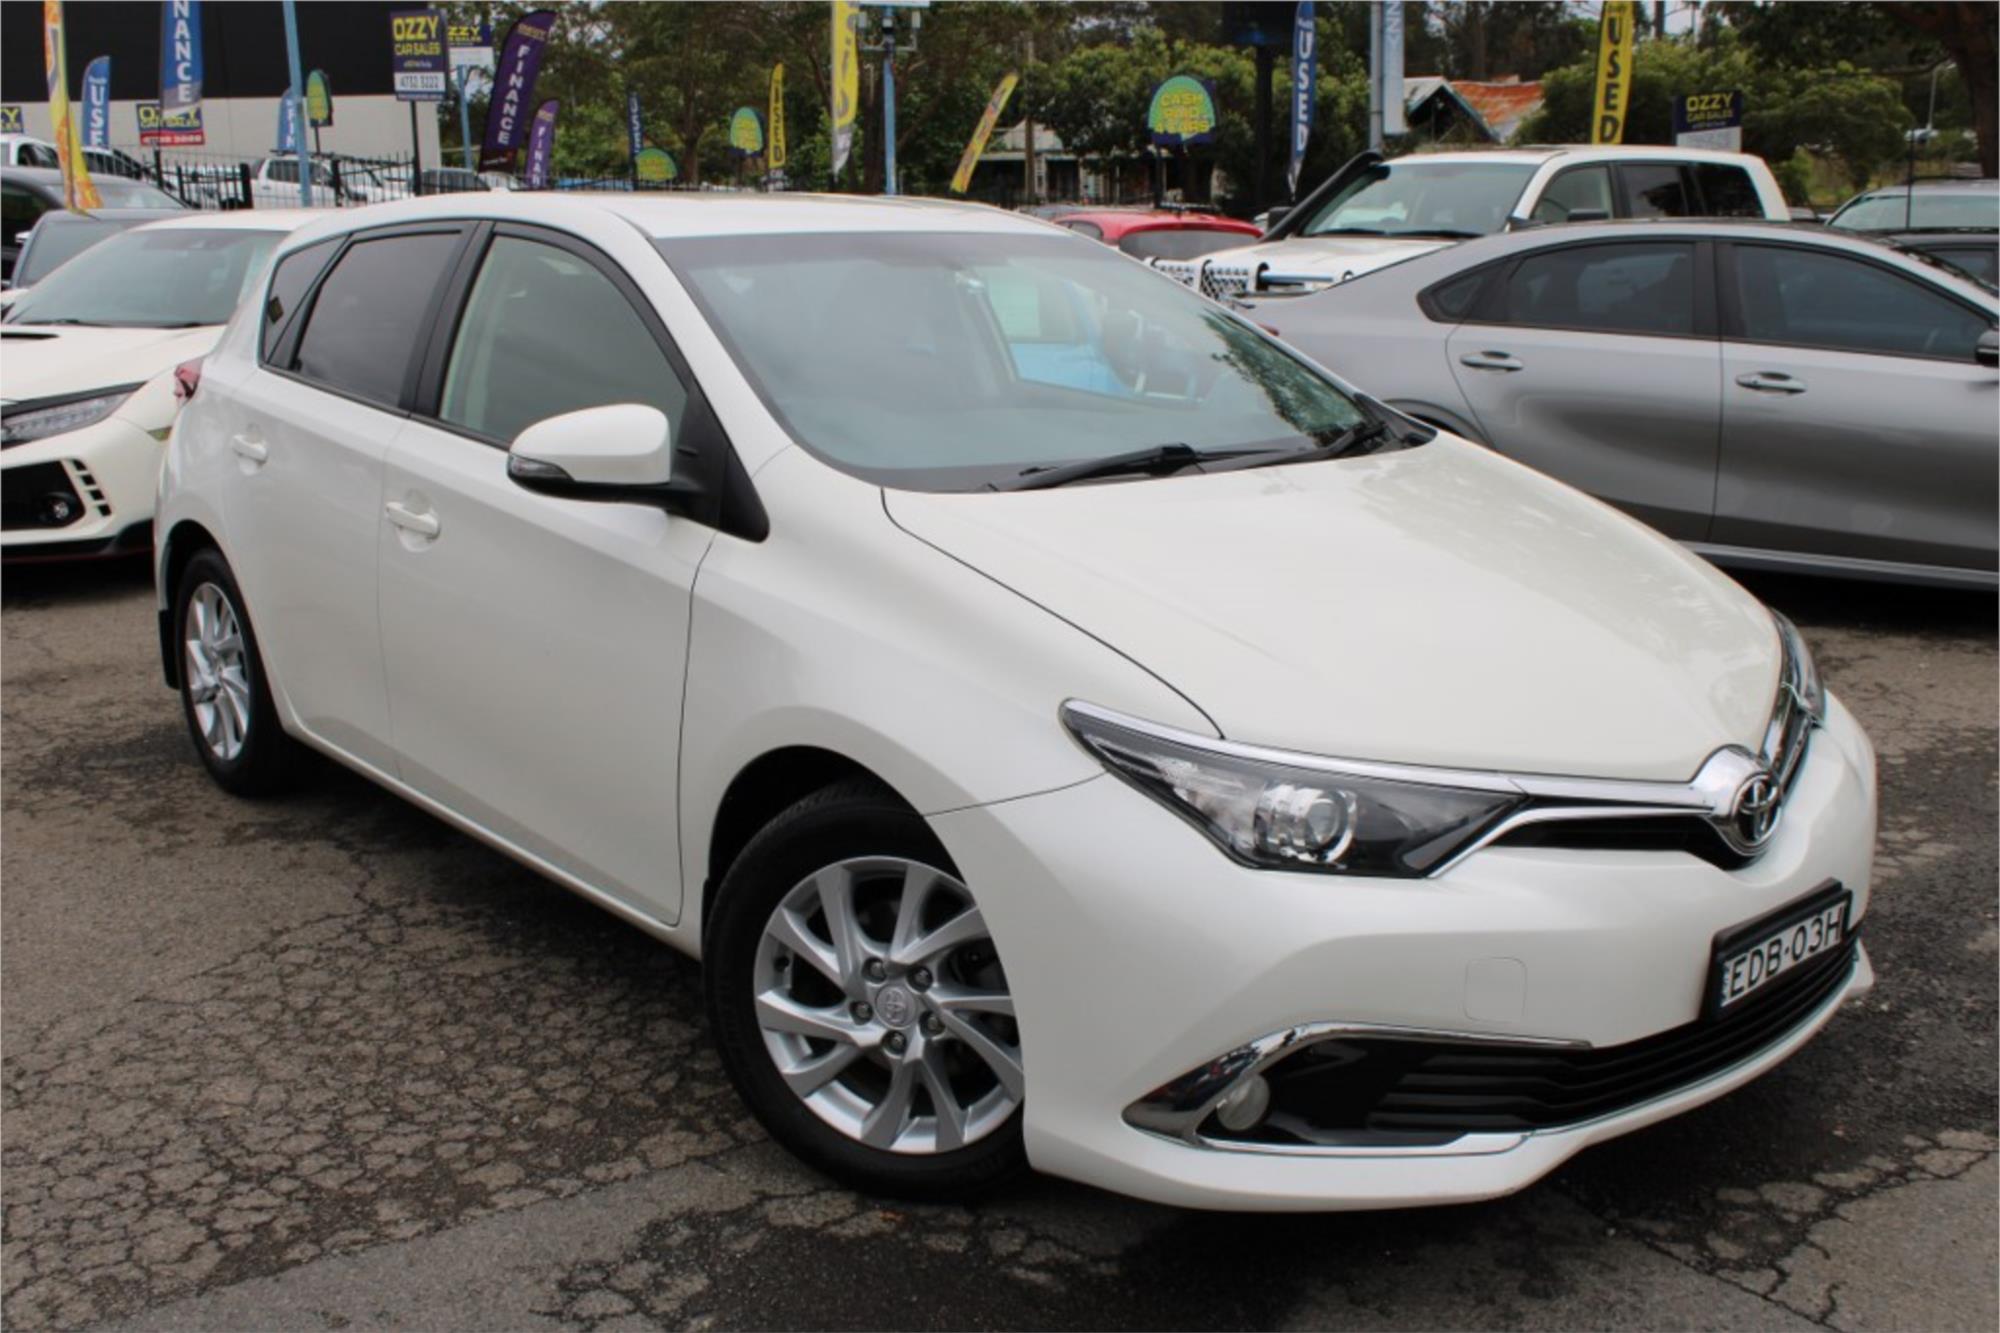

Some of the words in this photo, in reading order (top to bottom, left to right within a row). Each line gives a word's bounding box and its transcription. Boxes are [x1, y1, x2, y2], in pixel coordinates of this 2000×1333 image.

[393, 15, 439, 41] OZZY
[394, 43, 412, 56] CAR
[414, 42, 441, 55] SALES
[1298, 31, 1314, 151] USED
[1600, 17, 1622, 143] USED
[498, 45, 531, 145] FINANCE
[1685, 92, 1733, 112] OZZY
[1706, 109, 1733, 120] SALES
